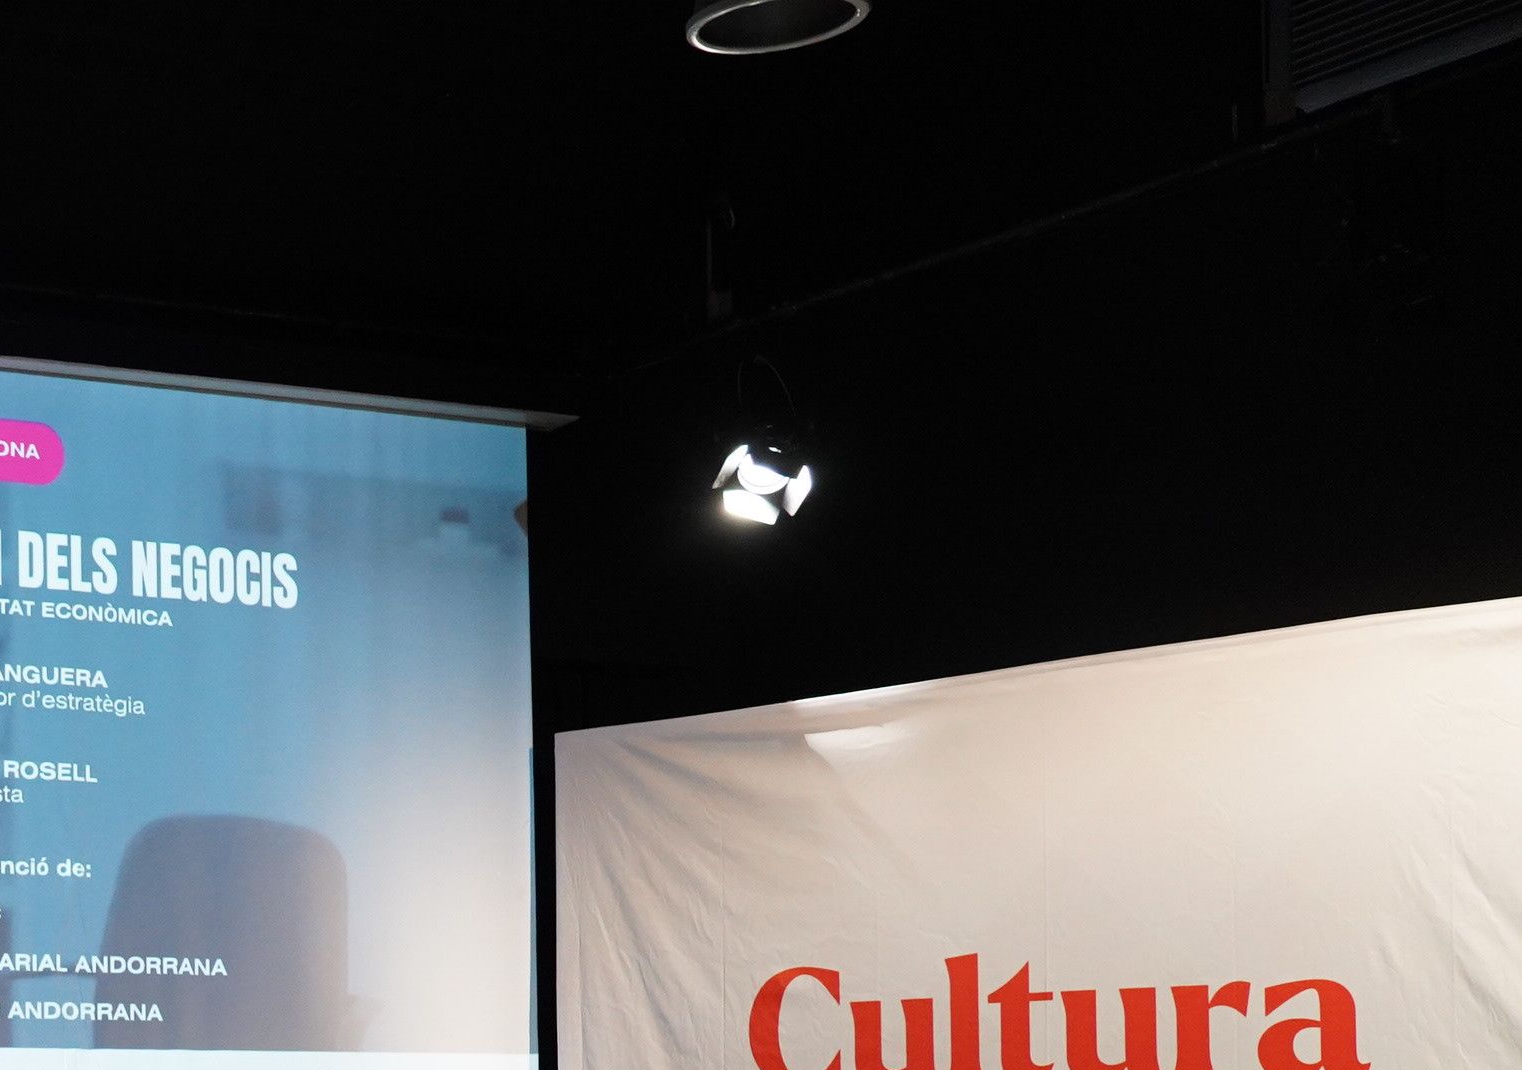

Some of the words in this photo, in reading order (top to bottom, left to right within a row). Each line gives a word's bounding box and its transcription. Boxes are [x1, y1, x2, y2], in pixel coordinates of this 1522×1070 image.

[18, 530, 118, 595] DELS
[132, 539, 298, 609] NEGOCIS
[41, 601, 174, 627] ECONÒMICA
[3, 759, 98, 783] ROSELL
[57, 858, 92, 878] de:
[74, 954, 228, 977] ANDORRANA
[8, 1001, 164, 1022] ANDORRANA
